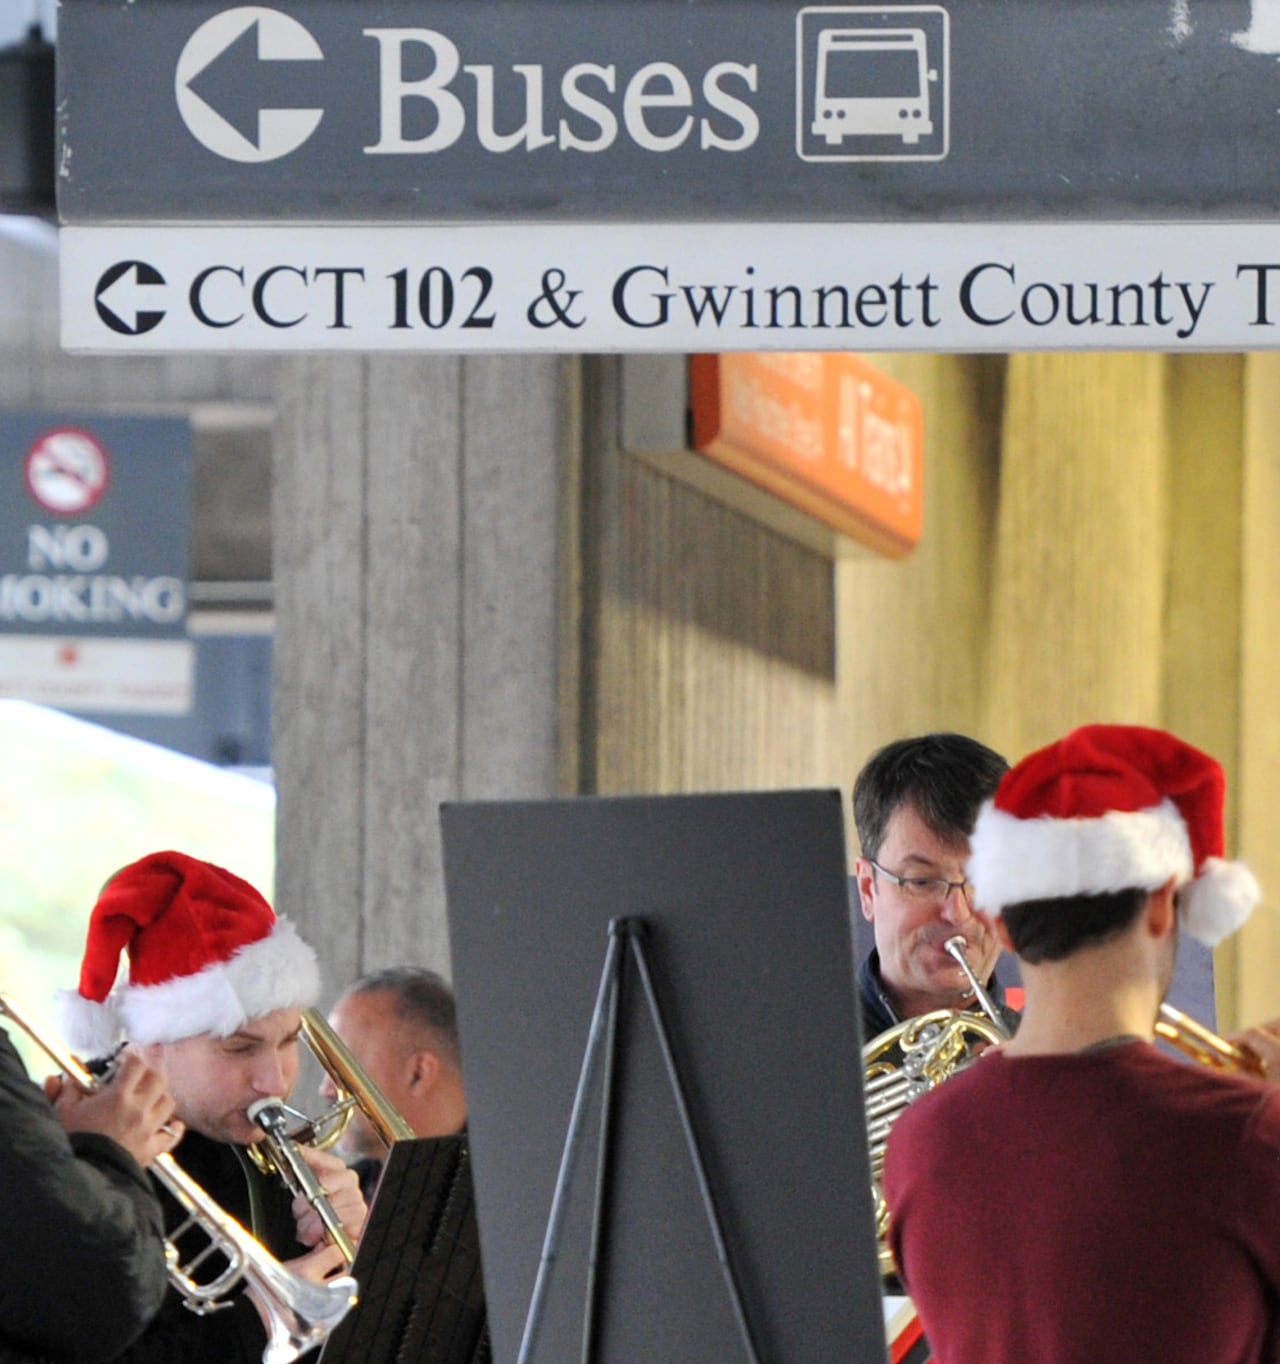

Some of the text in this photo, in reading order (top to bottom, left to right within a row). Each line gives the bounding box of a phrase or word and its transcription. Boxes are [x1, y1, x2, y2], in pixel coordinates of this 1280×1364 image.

[363, 27, 761, 155] Buses
[189, 264, 366, 330] CCT
[388, 266, 497, 331] 102
[526, 266, 587, 330] &
[611, 264, 941, 330] Gwinnett
[959, 262, 1213, 340] County
[27, 524, 111, 574] NO
